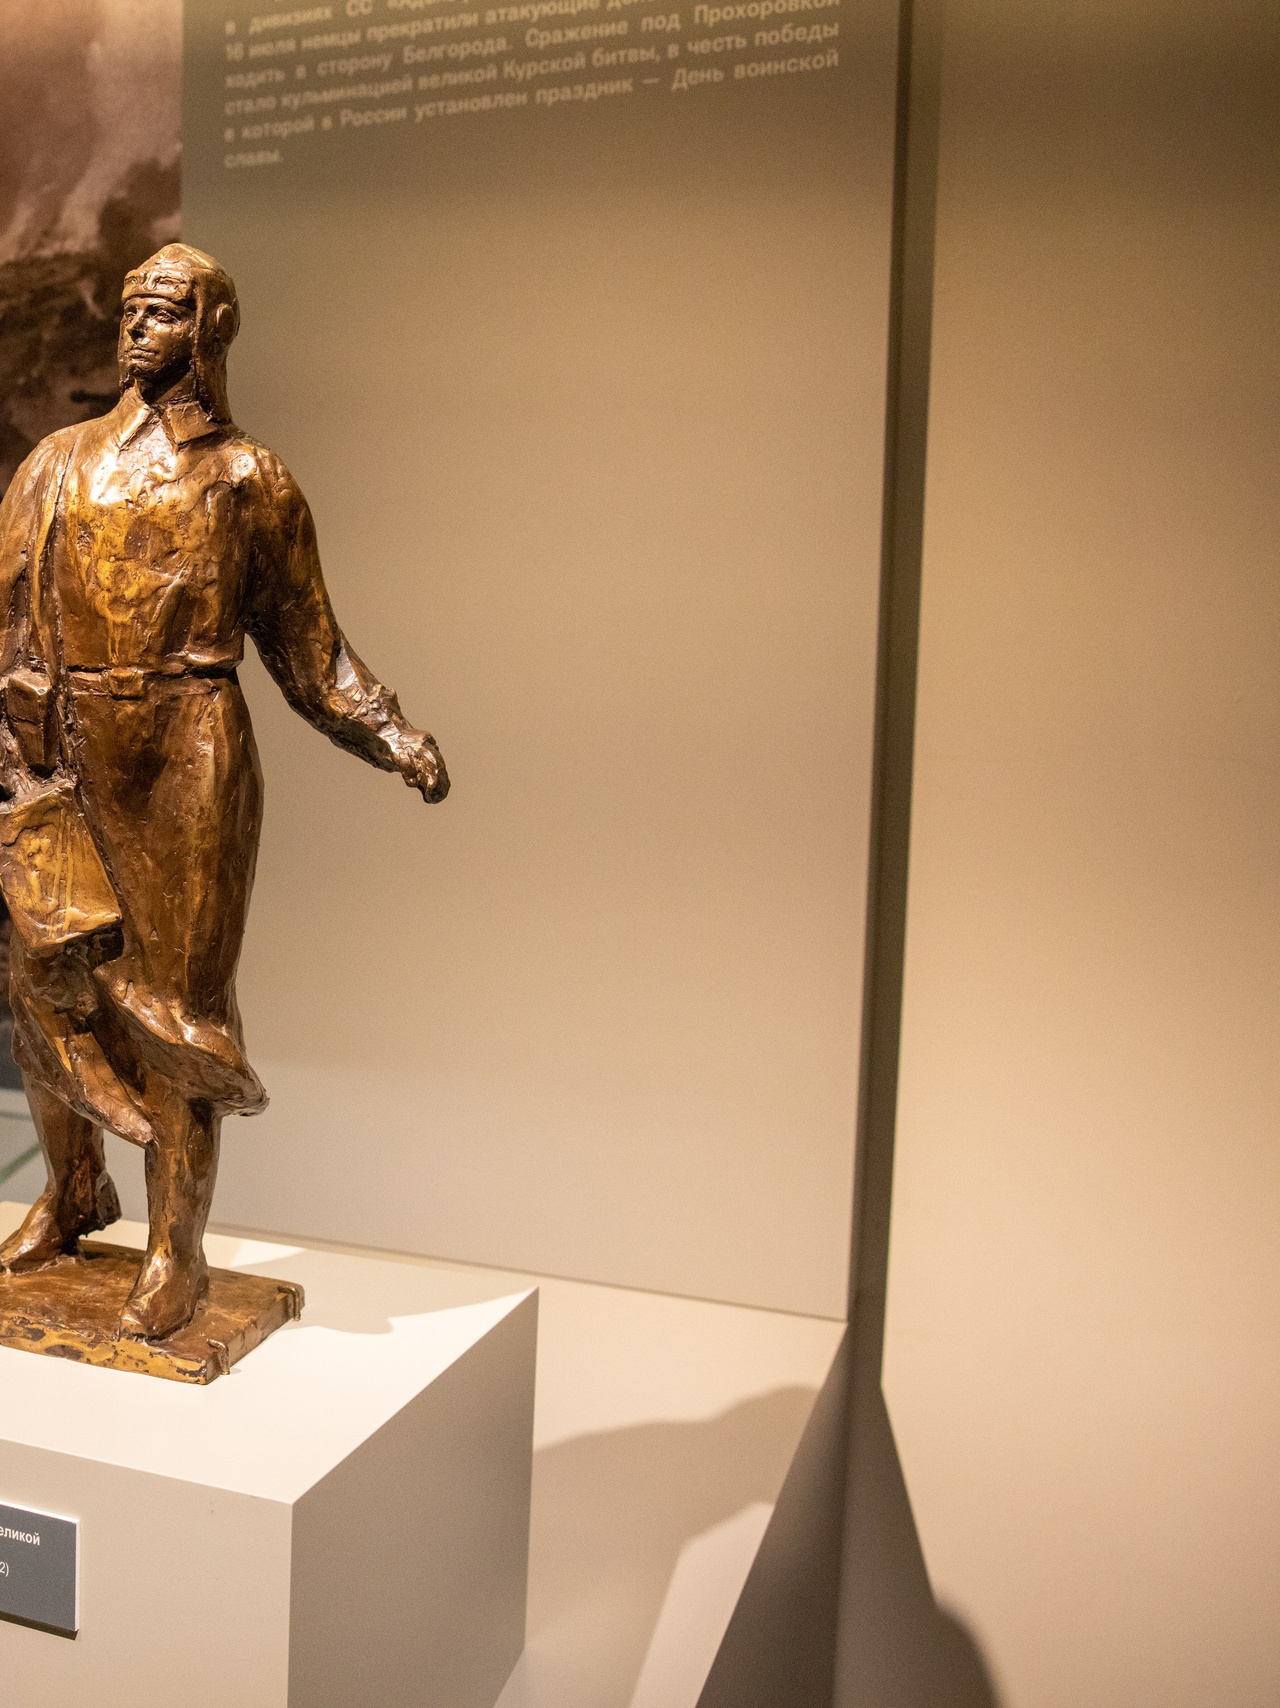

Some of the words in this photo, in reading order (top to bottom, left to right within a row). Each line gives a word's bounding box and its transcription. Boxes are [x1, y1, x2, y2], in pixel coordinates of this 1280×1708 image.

[317, 53, 393, 77] сторону
[402, 36, 514, 65] Белгорода.
[525, 20, 629, 49] Сражение
[641, 13, 681, 33] под
[366, 12, 479, 43] прекратили
[418, 62, 498, 90] великой
[503, 50, 587, 83] Курской
[591, 46, 661, 68] битвы,
[667, 43, 680, 59] в
[687, 34, 748, 55] честь
[754, 22, 840, 47] победы
[338, 107, 408, 128] России
[414, 90, 529, 124] установлен
[534, 77, 634, 107] праздник
[671, 67, 725, 91] День
[733, 49, 840, 81] воинской
